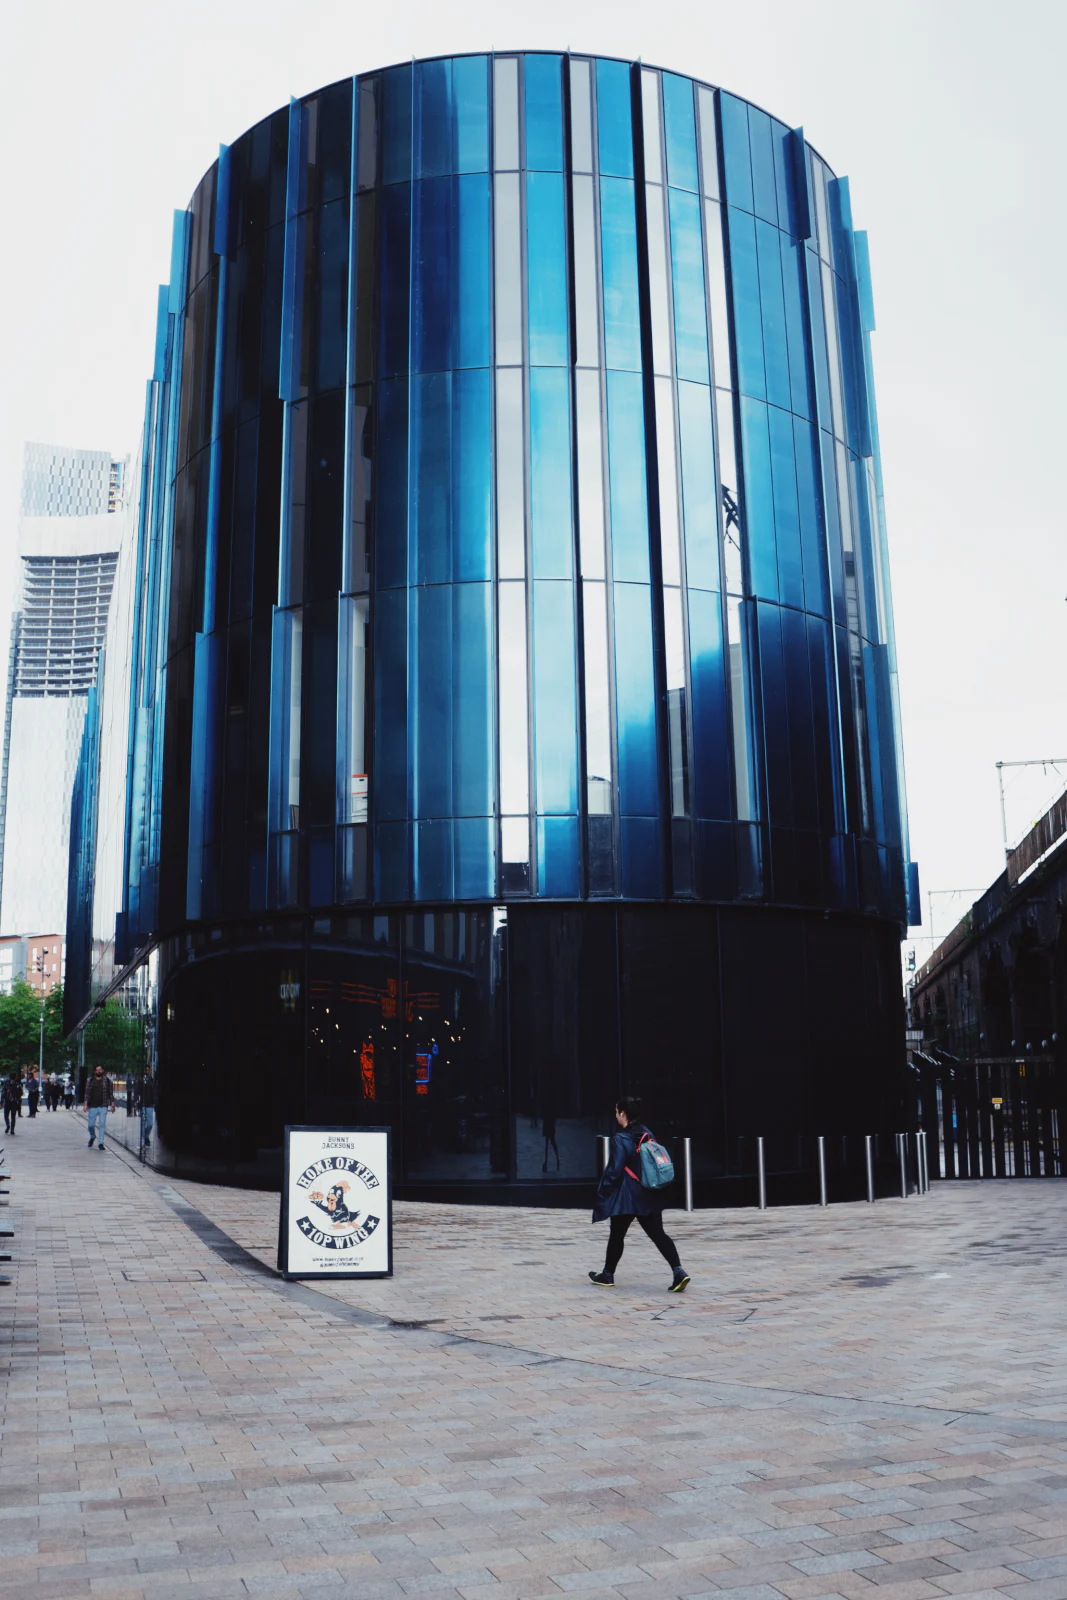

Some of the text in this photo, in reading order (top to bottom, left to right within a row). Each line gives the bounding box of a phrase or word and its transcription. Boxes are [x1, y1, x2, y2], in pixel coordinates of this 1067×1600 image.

[299, 1157, 378, 1189] HOME OF THE
[334, 1229, 368, 1249] WING
